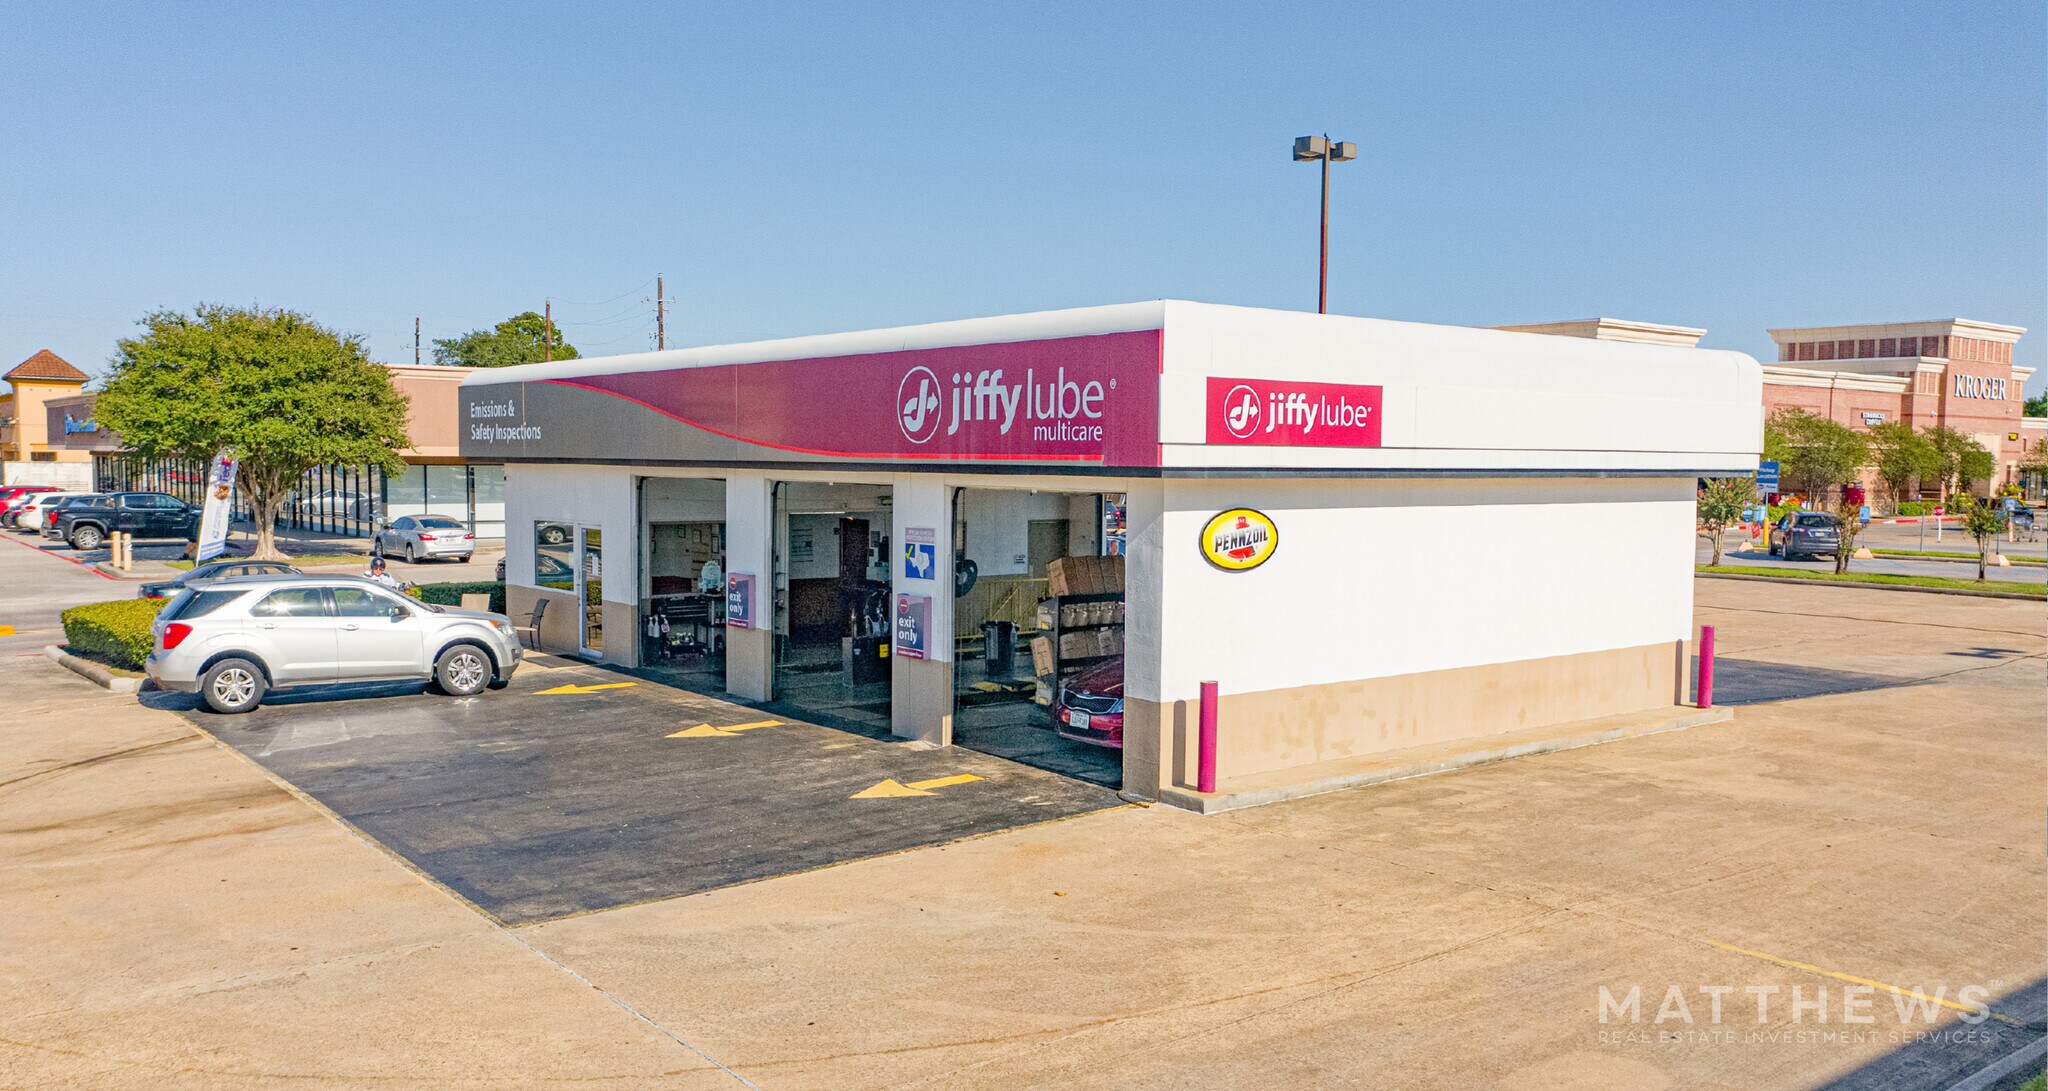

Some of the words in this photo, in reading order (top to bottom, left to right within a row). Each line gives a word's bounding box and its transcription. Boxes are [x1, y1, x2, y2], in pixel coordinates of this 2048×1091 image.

[1954, 374, 2007, 400] KROGER
[470, 401, 507, 418] Emissions
[508, 400, 515, 417] &
[947, 369, 1023, 436] jiffy
[1265, 392, 1319, 434] jiffy
[471, 423, 494, 444] Safety
[495, 422, 541, 444] Inspections
[1033, 420, 1103, 441] multicare
[1214, 525, 1269, 553] PENNZOIL
[729, 591, 742, 603] exit
[729, 602, 744, 616] only
[898, 615, 916, 629] exit
[898, 628, 918, 645] only
